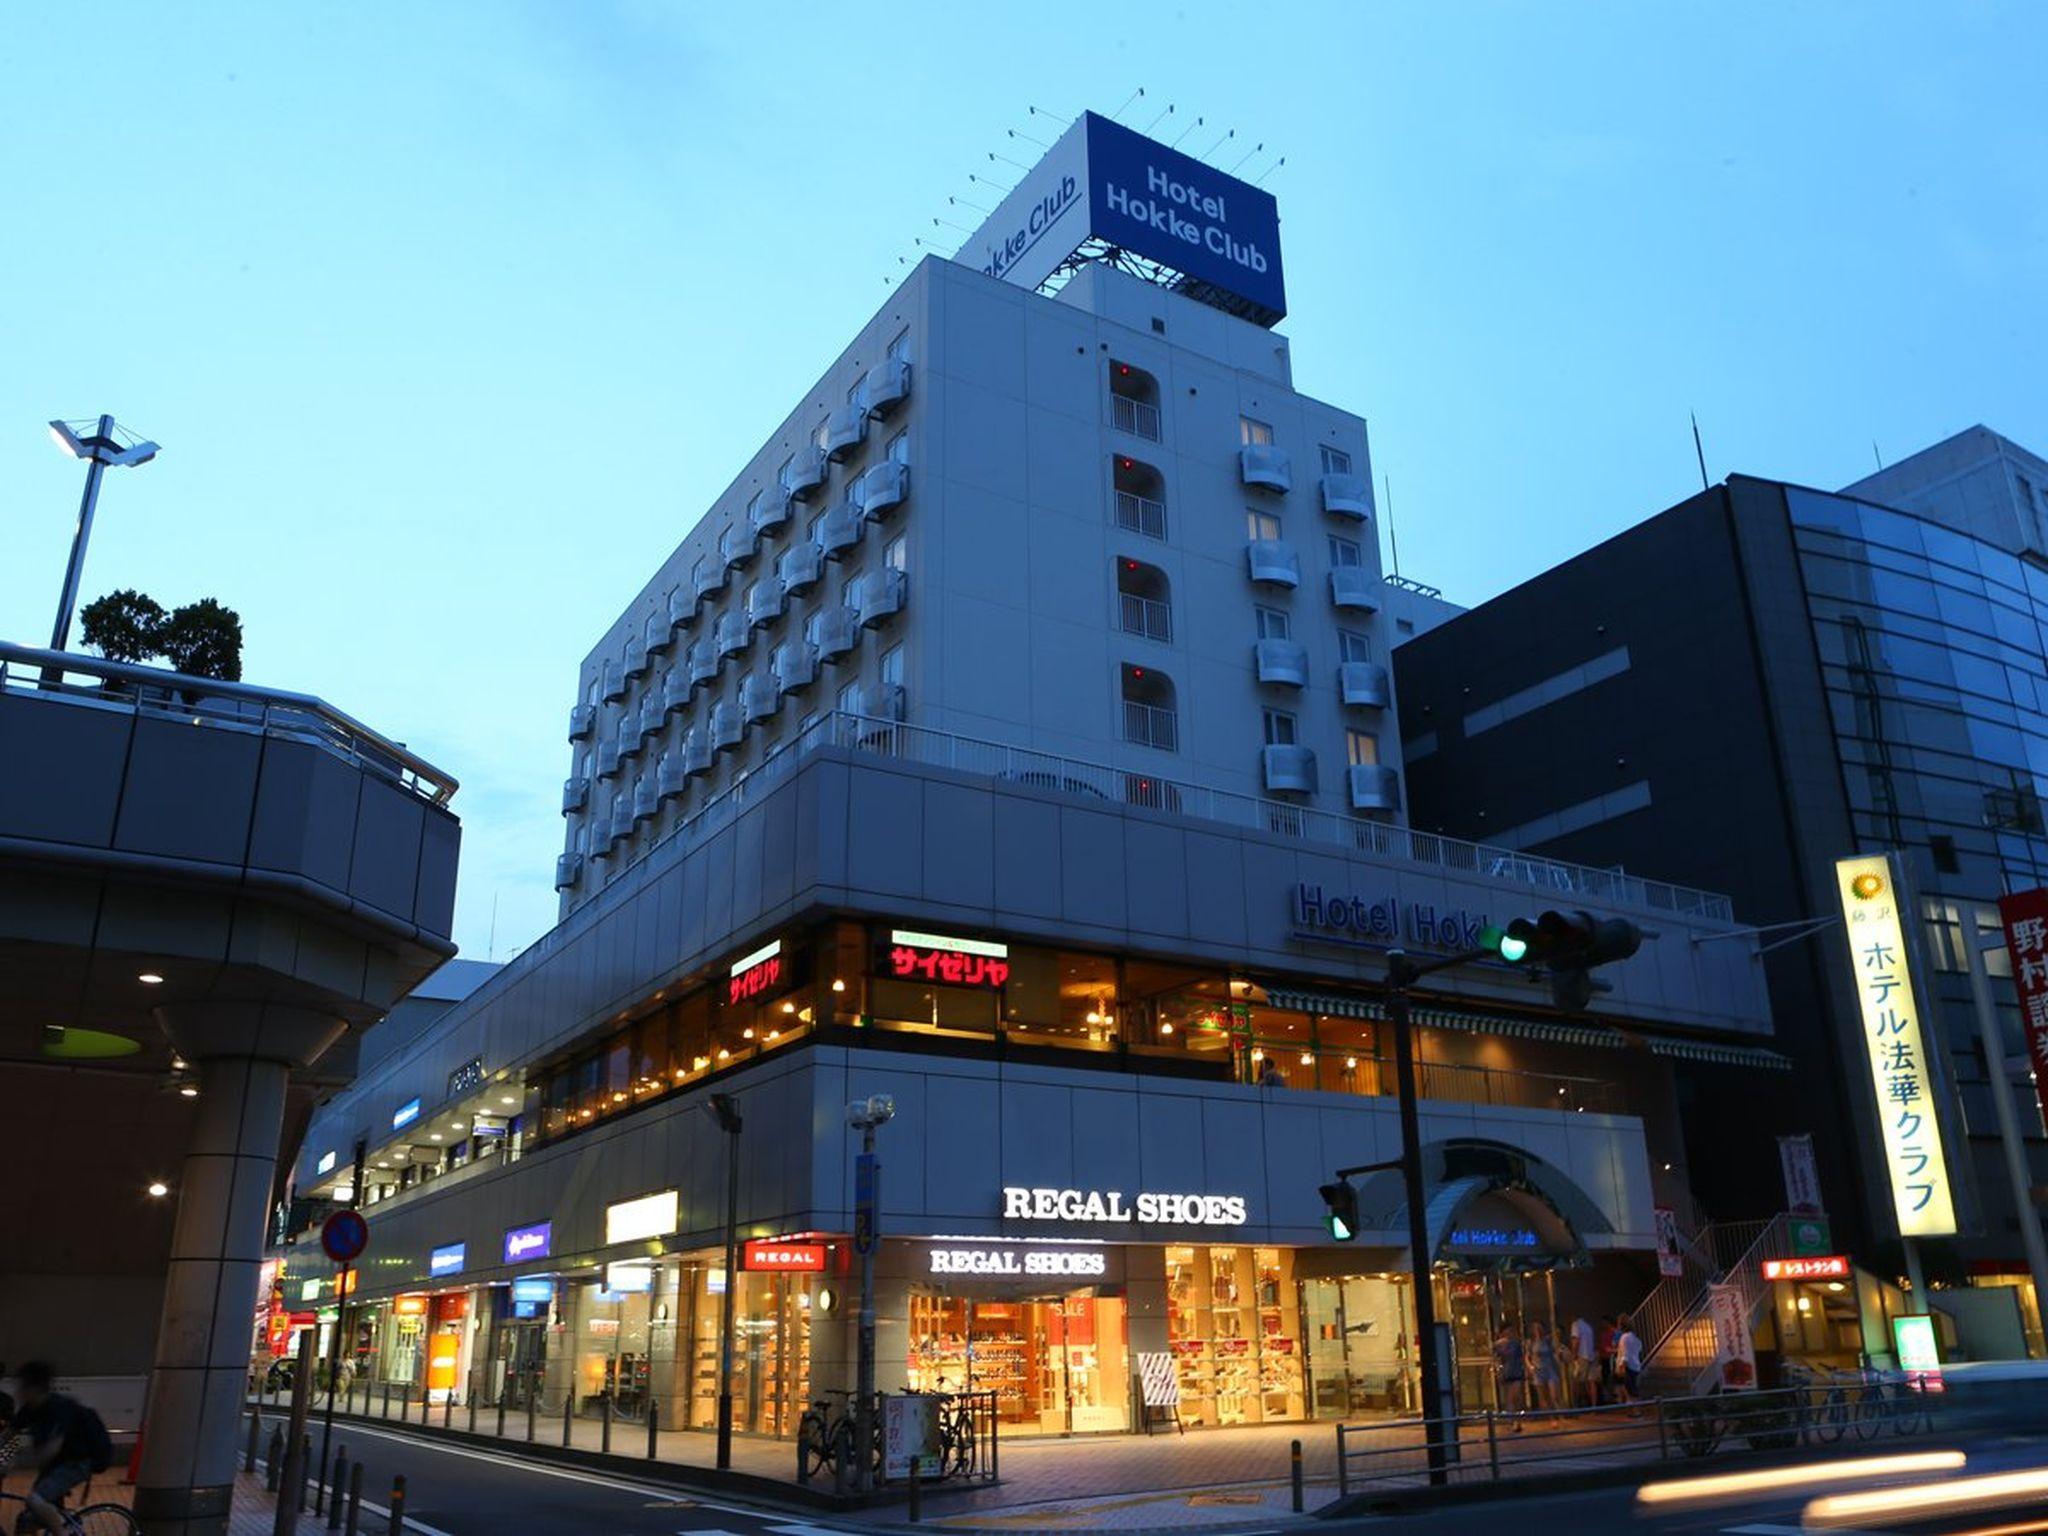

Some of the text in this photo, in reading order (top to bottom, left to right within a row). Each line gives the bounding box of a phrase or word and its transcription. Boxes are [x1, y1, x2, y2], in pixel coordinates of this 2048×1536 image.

[1029, 176, 1075, 235] Club
[1148, 165, 1226, 223] Hotel
[1107, 182, 1267, 273] Hokke Club
[1300, 883, 1398, 935] Hotel
[730, 957, 780, 1005] サイゼリヤ
[892, 946, 1009, 988] サイゼリヤ
[1863, 941, 1938, 1212] ホテル法華クラブ
[1003, 1187, 1247, 1225] REGAL SHOES
[755, 1253, 815, 1263] REGAL
[930, 1250, 1105, 1275] REGAL SHOES
